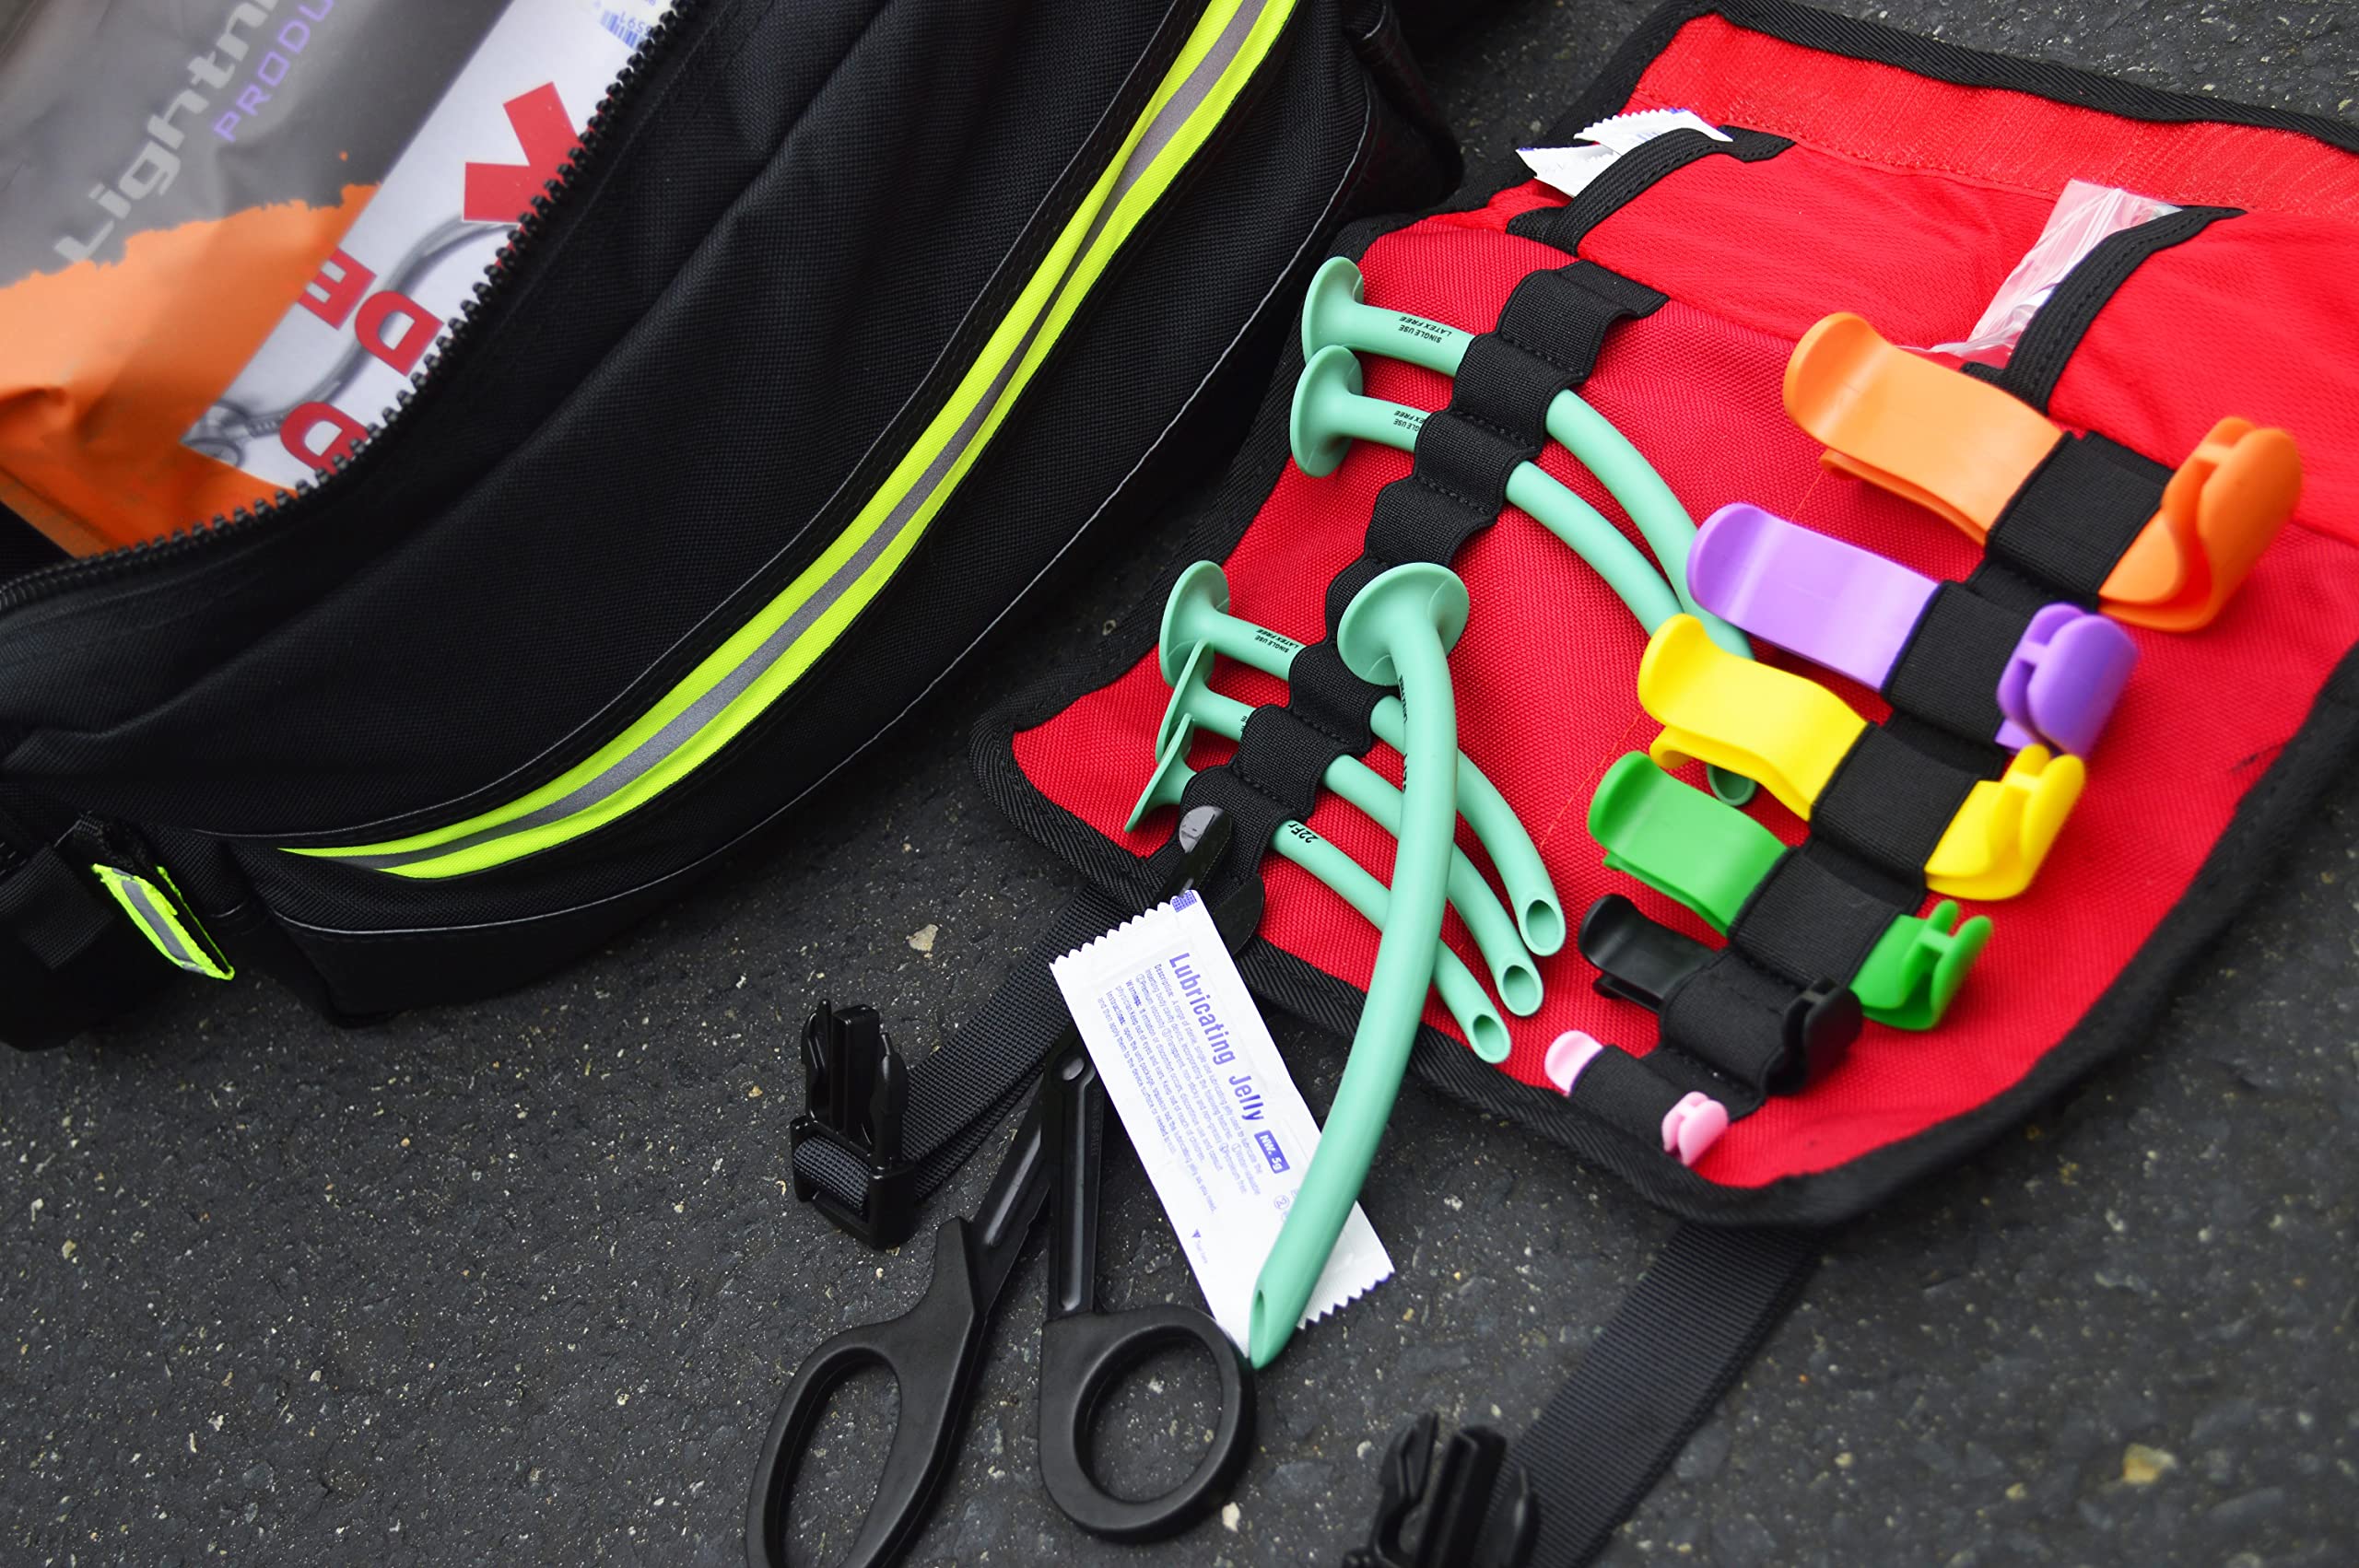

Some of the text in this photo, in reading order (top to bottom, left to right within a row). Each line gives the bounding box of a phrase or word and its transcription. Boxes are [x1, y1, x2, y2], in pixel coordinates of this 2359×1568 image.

[53, 0, 277, 264] Lightn
[1398, 324, 1442, 344] SINGLE USE
[1399, 316, 1452, 337] LATEX FREE
[1393, 410, 1415, 420] FREE
[1393, 418, 1407, 427] USE
[1254, 635, 1290, 653] SINGLE USE
[1256, 628, 1299, 649] LATEX FREE
[1287, 823, 1319, 844] 22Fr
[1097, 997, 1107, 1009] and
[1102, 1007, 1112, 1022] then
[1109, 1021, 1120, 1037] apply
[1116, 1036, 1127, 1052] them
[1122, 1049, 1130, 1059] to
[1126, 1057, 1134, 1069] the
[1131, 1067, 1144, 1087] device
[1140, 1085, 1155, 1108] surface
[1156, 1115, 1168, 1137] needed
[1106, 990, 1125, 1025] Instructions:
[1122, 1026, 1133, 1042] open
[1129, 1039, 1137, 1051] the
[1133, 1049, 1144, 1063] unit
[1152, 1087, 1167, 1111] squeeze
[1164, 1110, 1172, 1122] out
[1168, 1119, 1177, 1131] the
[1173, 1130, 1192, 1164] lubricating
[1134, 1024, 1144, 1036] out
[1142, 1040, 1153, 1056] eyes
[1148, 1054, 1159, 1067] and
[1162, 1079, 1172, 1095] Keep
[1168, 1094, 1178, 1106] out
[1173, 1104, 1181, 1112] of
[1177, 1111, 1189, 1129] reach
[1141, 1013, 1156, 1036] irritation
[1156, 1043, 1174, 1072] discomfort
[1180, 1093, 1199, 1126] discontinue
[1202, 1137, 1214, 1151] and
[1149, 1004, 1165, 1029] viscosity
[1182, 1069, 1200, 1099] non-sticky
[1195, 1098, 1207, 1111] and
[1154, 963, 1173, 997] Description:
[1173, 1004, 1185, 1020] range
[1193, 1045, 1206, 1063] single
[1202, 1062, 1213, 1074] use
[1208, 1073, 1227, 1106] lubricating
[1228, 1116, 1241, 1130] used
[1237, 1129, 1245, 1138] to
[1155, 991, 1167, 1007] body
[1162, 1006, 1175, 1024] cavity
[1180, 1042, 1203, 1080] incorporating
[1198, 1078, 1208, 1089] the
[1203, 1088, 1221, 1116] following
[1169, 953, 1283, 1171] Lubricating Jelly NW. 5g
